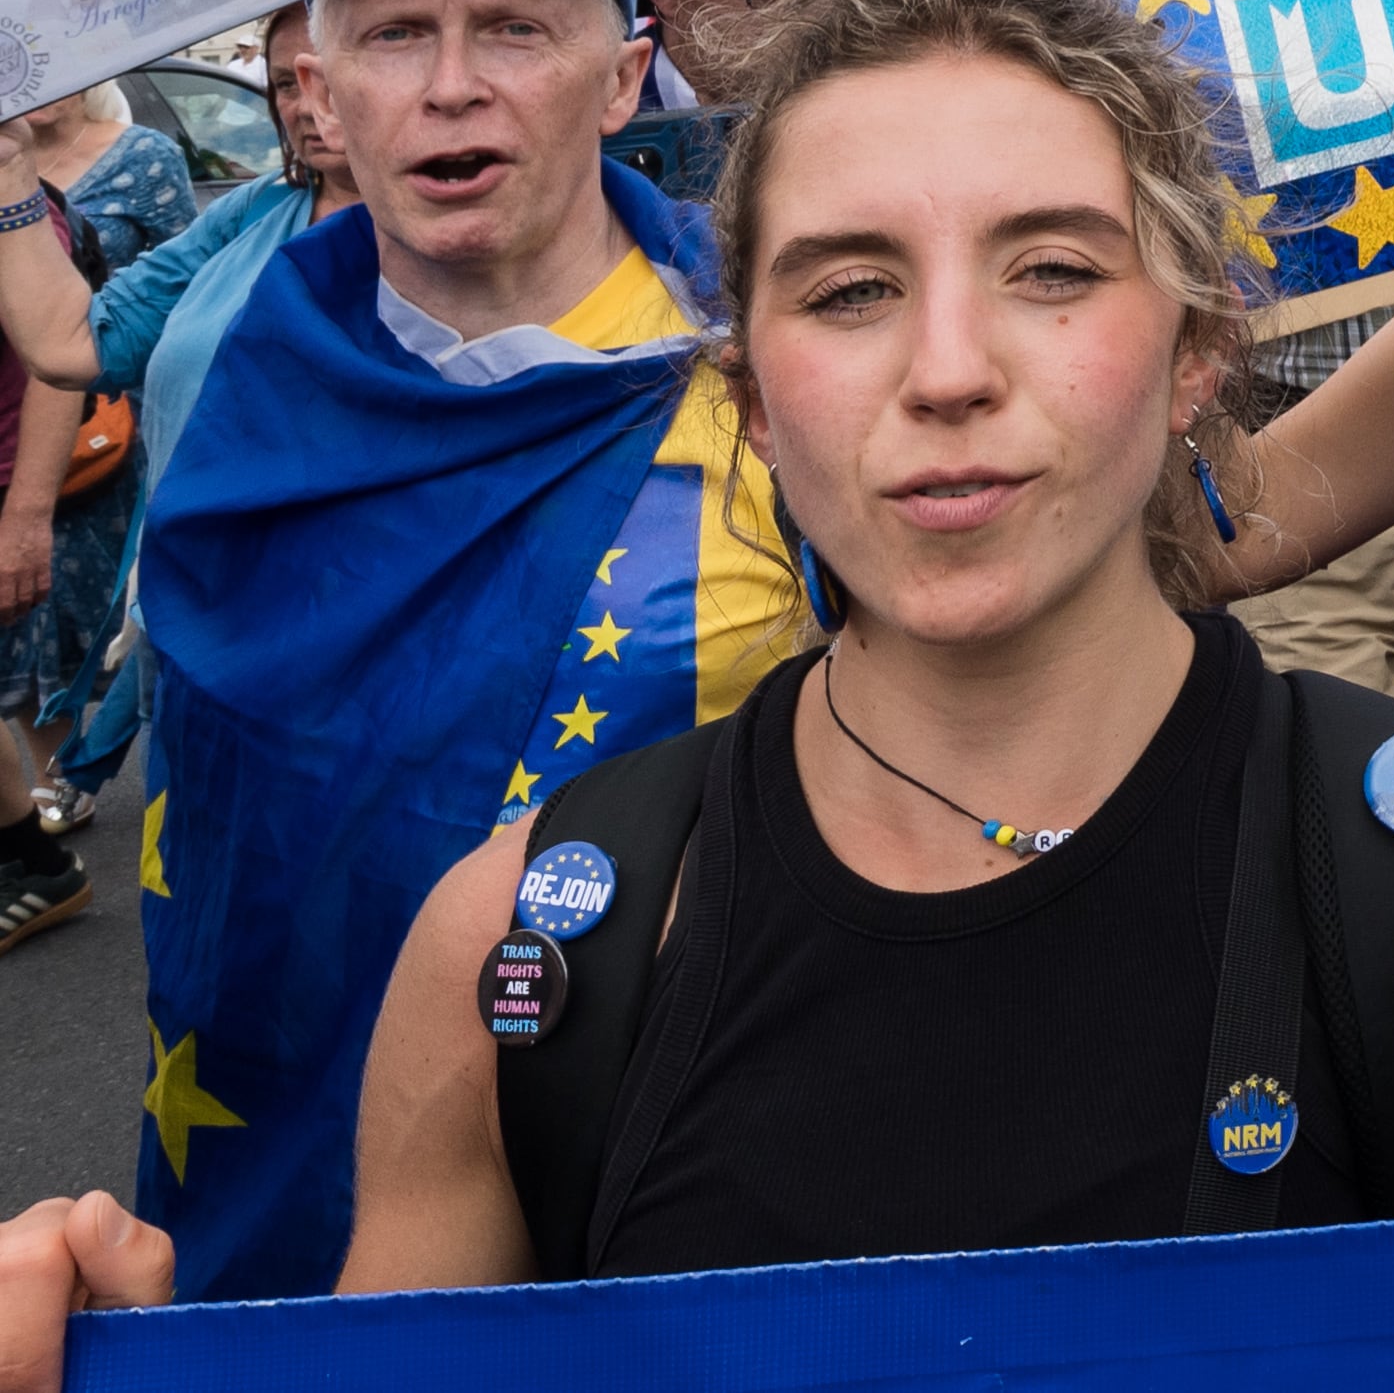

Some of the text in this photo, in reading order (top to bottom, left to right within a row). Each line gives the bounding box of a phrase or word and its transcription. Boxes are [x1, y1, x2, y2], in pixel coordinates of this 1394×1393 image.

[0, 16, 43, 46] ood
[10, 51, 50, 107] Banks
[519, 871, 612, 914] REJOIN
[502, 944, 543, 960] TRANS
[497, 963, 543, 978] RIGHTS
[505, 981, 530, 995] ARE
[493, 1000, 541, 1015] HUMAN
[492, 1018, 539, 1034] RIGHTS
[1223, 1121, 1282, 1152] NRM
